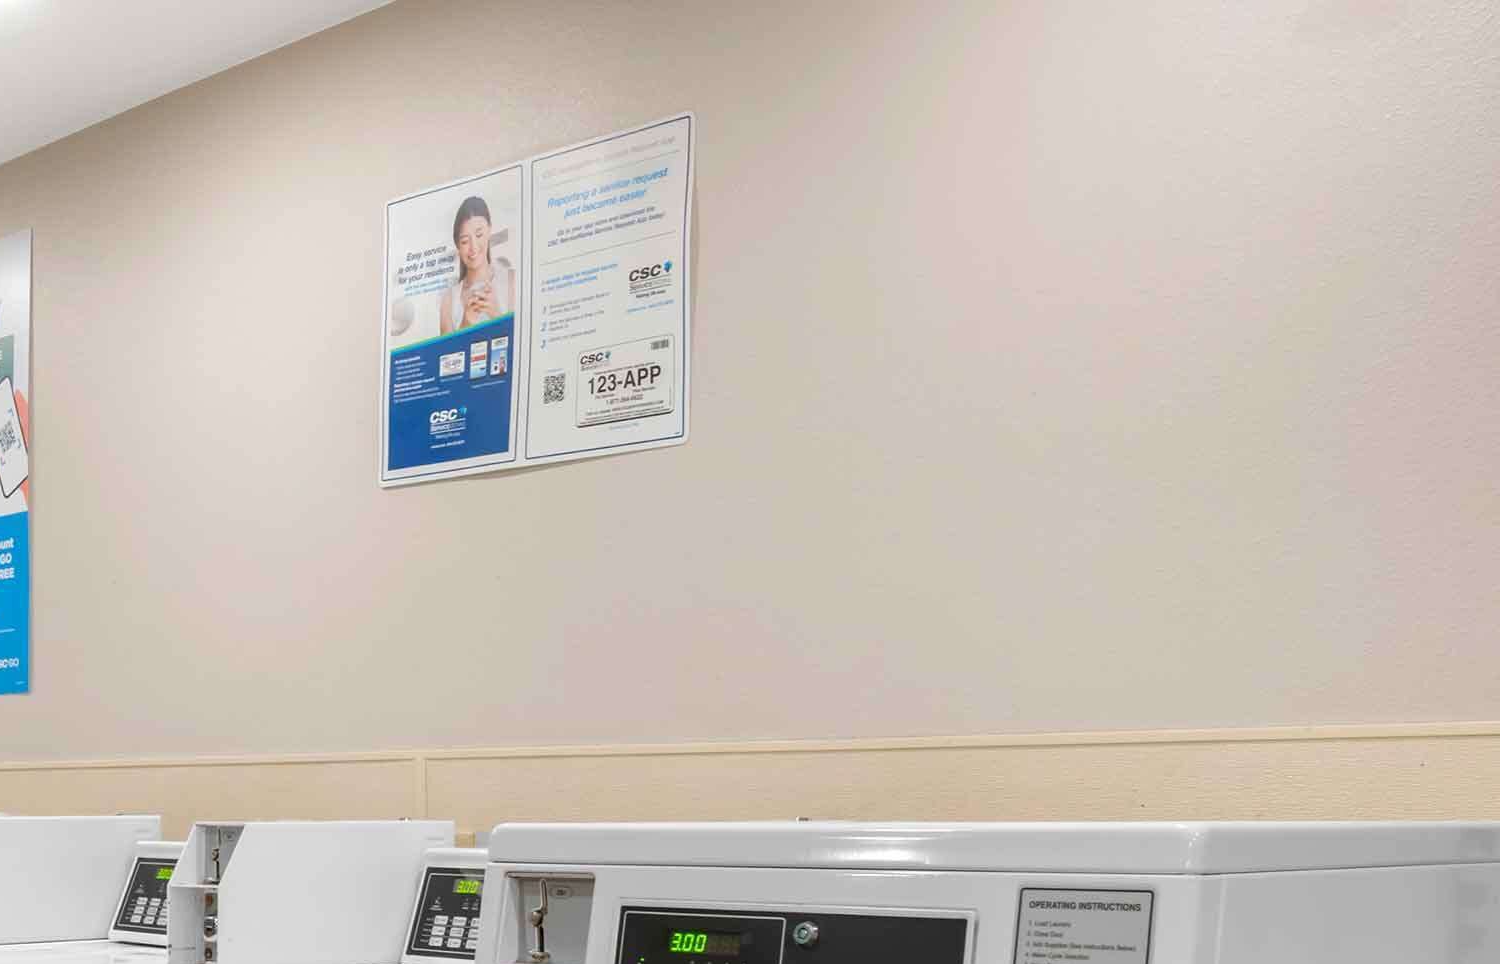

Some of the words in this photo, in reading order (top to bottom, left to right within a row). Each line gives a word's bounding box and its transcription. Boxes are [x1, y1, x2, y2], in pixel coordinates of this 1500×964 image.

[629, 263, 662, 282] CSC
[580, 352, 604, 365] CSC
[587, 365, 662, 395] 123-APP
[429, 408, 458, 424] CSC
[0, 552, 12, 565] GO
[1029, 900, 1077, 910] OPERATING
[1078, 902, 1141, 912] INSTRUCTIONS
[670, 932, 708, 953] 3.00
